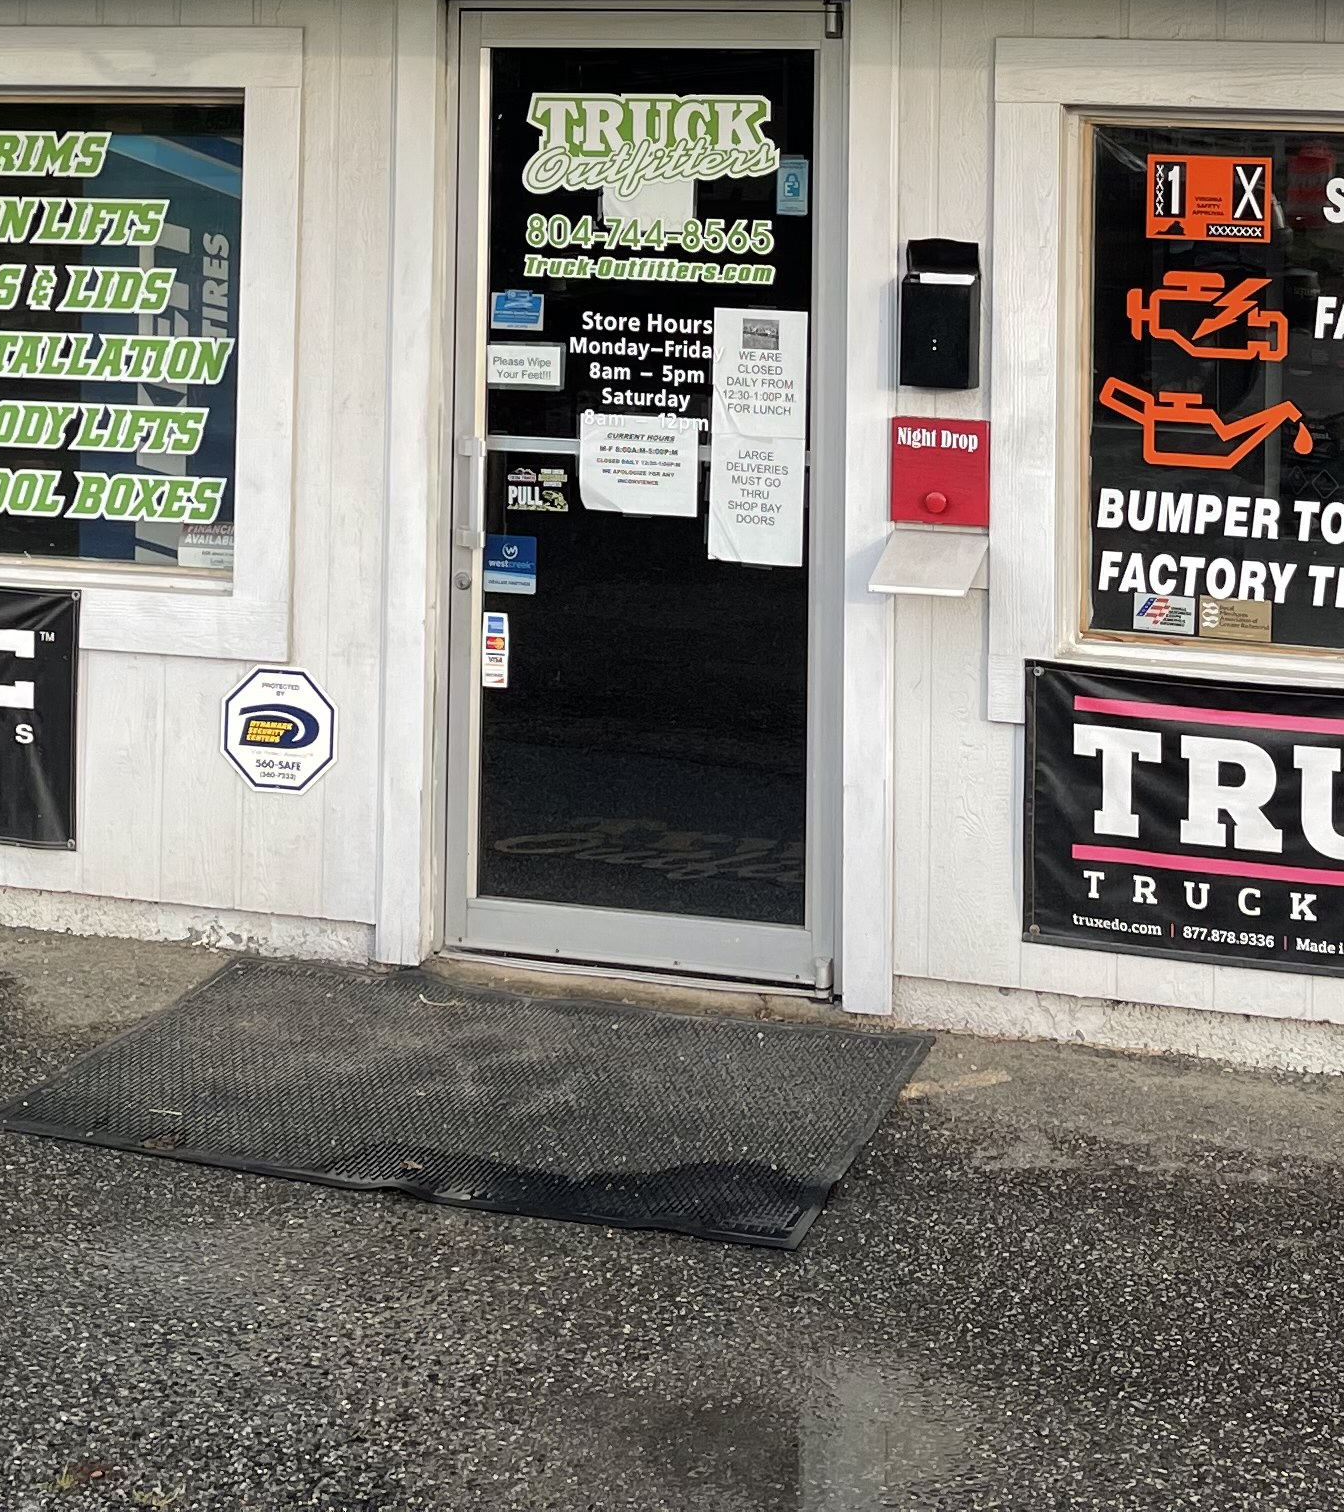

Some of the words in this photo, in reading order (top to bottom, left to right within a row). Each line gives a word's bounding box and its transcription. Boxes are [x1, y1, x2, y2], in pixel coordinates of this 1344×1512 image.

[527, 94, 770, 154] TRUCK
[522, 138, 779, 201] Outfitters
[1168, 165, 1180, 214] 1
[1234, 166, 1263, 219] X
[30, 199, 169, 245] LIFTS
[526, 214, 774, 254] 804-744-8565
[524, 254, 776, 286] Truck-Outfitters.com
[27, 265, 56, 310] &
[56, 266, 177, 314] LIDS
[582, 311, 640, 331] Store
[647, 314, 713, 335] Hours
[493, 356, 524, 366] Please
[527, 358, 551, 368] Wipe
[739, 351, 756, 361] WE
[759, 352, 782, 362] ARE
[497, 369, 518, 379] Your
[589, 362, 631, 380] 8am
[662, 365, 705, 386] 5pm
[738, 365, 783, 375] CLOSED
[727, 377, 757, 387] DAILY
[761, 379, 794, 389] FROM
[602, 387, 690, 412] Saturday
[728, 404, 750, 414] FOR
[754, 405, 791, 415] LUNCH
[69, 403, 209, 454] LIFTS
[584, 409, 625, 426] 8am
[658, 412, 709, 431] 12pm
[607, 432, 644, 441] CURRENT
[647, 435, 675, 443] HOURS
[897, 427, 937, 447] Night
[941, 430, 979, 452] Drop
[739, 450, 774, 461] LARGE
[726, 462, 789, 475] DELIVERIES
[732, 475, 761, 486] MUST
[764, 477, 781, 487] GO
[64, 471, 226, 523] BOXES
[508, 486, 543, 505] PULL
[741, 489, 770, 499] THRU
[728, 501, 757, 512] SHOP
[761, 503, 782, 513] BAY
[1097, 487, 1280, 540] BUMPER
[736, 515, 775, 526] DOORS
[184, 535, 234, 546] AVAILABL
[1098, 551, 1297, 606] FACTORY
[40, 632, 55, 642] TM
[262, 682, 300, 690] PROTECTED
[256, 760, 301, 771] 560-SAFE
[1083, 871, 1319, 924] TRUCK
[1073, 913, 1162, 936] truxedo.com
[1183, 925, 1275, 948] 877.878.9336
[1296, 937, 1335, 955] Made
